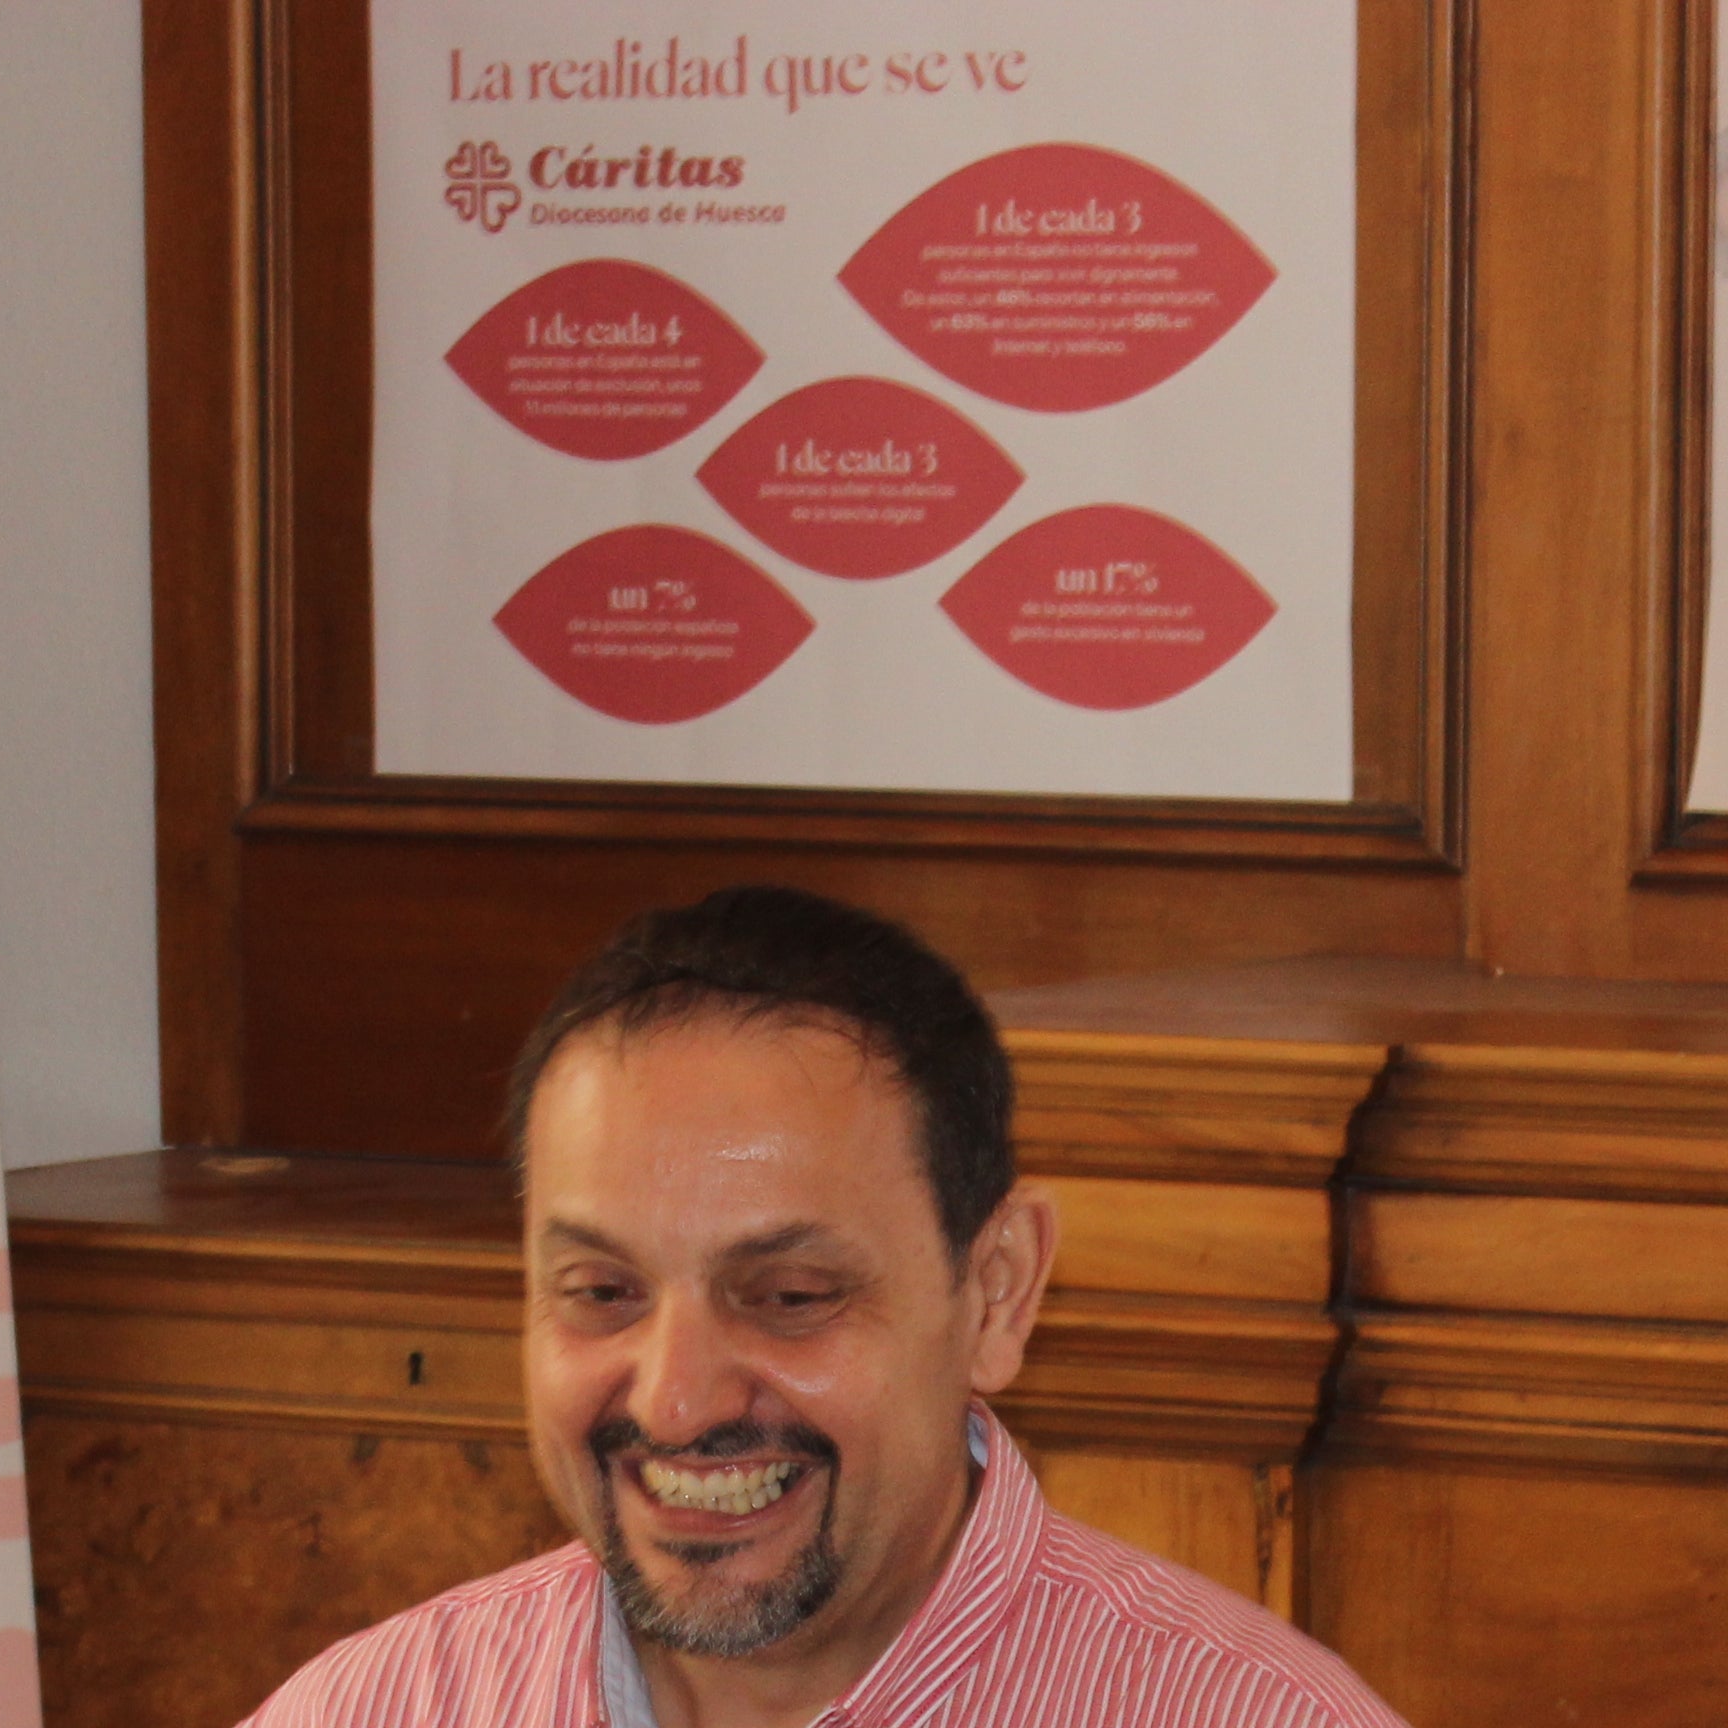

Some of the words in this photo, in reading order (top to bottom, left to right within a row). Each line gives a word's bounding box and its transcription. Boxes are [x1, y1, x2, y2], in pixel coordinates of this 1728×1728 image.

[449, 46, 514, 102] La
[528, 34, 748, 100] realidad
[763, 48, 871, 114] que
[882, 48, 951, 95] se
[963, 47, 1029, 93] ve
[528, 139, 746, 190] Cáritas
[529, 201, 651, 226] Diocesana
[657, 200, 687, 224] de
[693, 201, 787, 225] Huesca
[991, 197, 1034, 236] de
[1037, 197, 1116, 236] cada
[1124, 201, 1143, 235] 3
[543, 311, 580, 347] de
[585, 311, 657, 347] cada
[663, 314, 683, 347] 4
[792, 438, 832, 474] de
[837, 438, 912, 475] cada
[919, 442, 939, 475] 3
[1054, 568, 1098, 594] un
